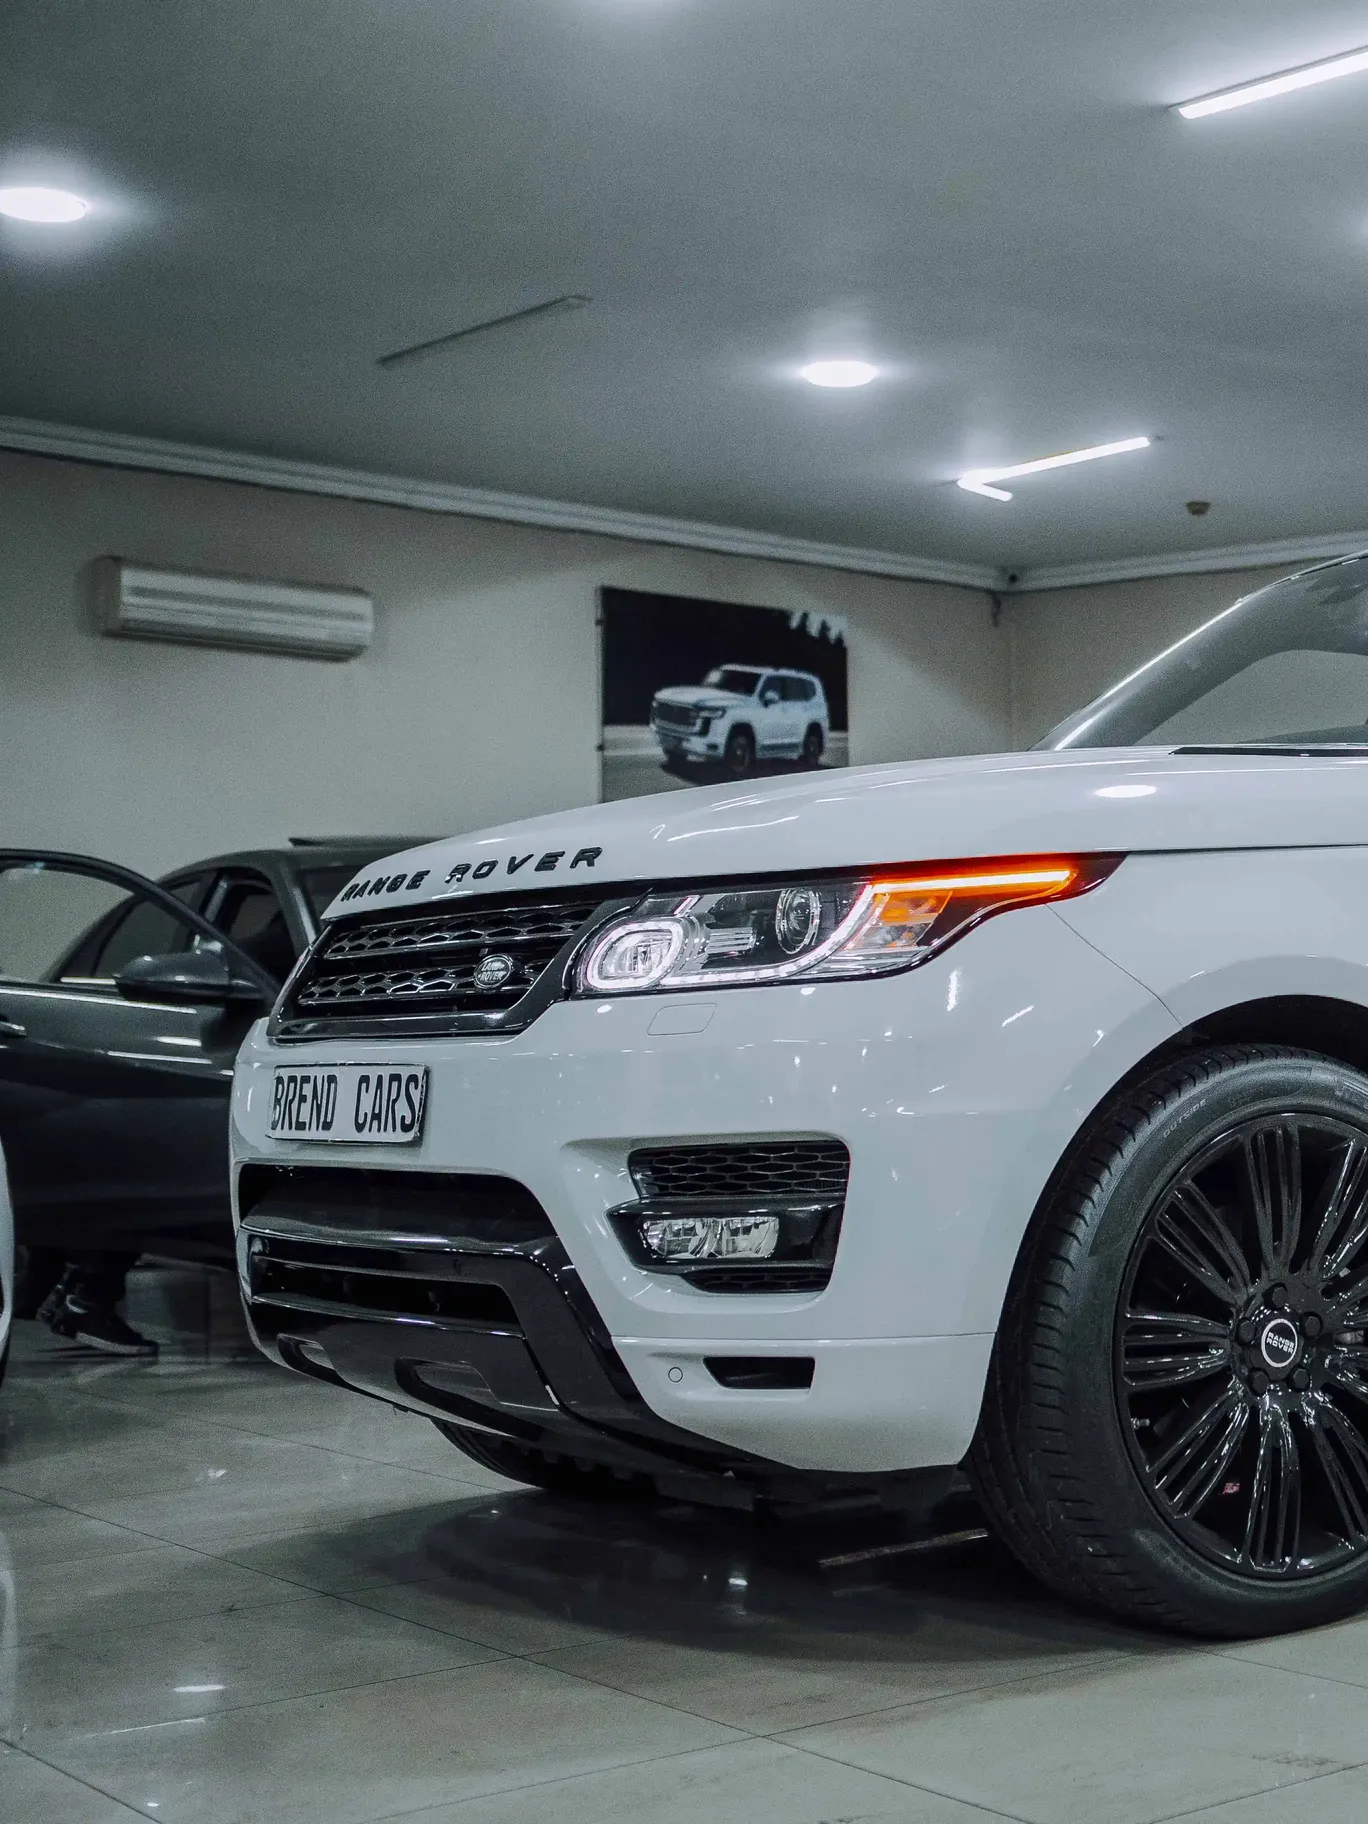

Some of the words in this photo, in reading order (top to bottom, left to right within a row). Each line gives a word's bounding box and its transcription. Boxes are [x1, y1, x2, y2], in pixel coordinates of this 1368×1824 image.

[340, 869, 430, 902] RANGE
[444, 846, 603, 884] ROVER
[270, 1074, 338, 1131] BREND
[354, 1073, 419, 1133] CARS
[1163, 1098, 1207, 1138] OUTSIDE
[1266, 1337, 1294, 1354] ROVER
[1267, 1331, 1295, 1349] RANGE
